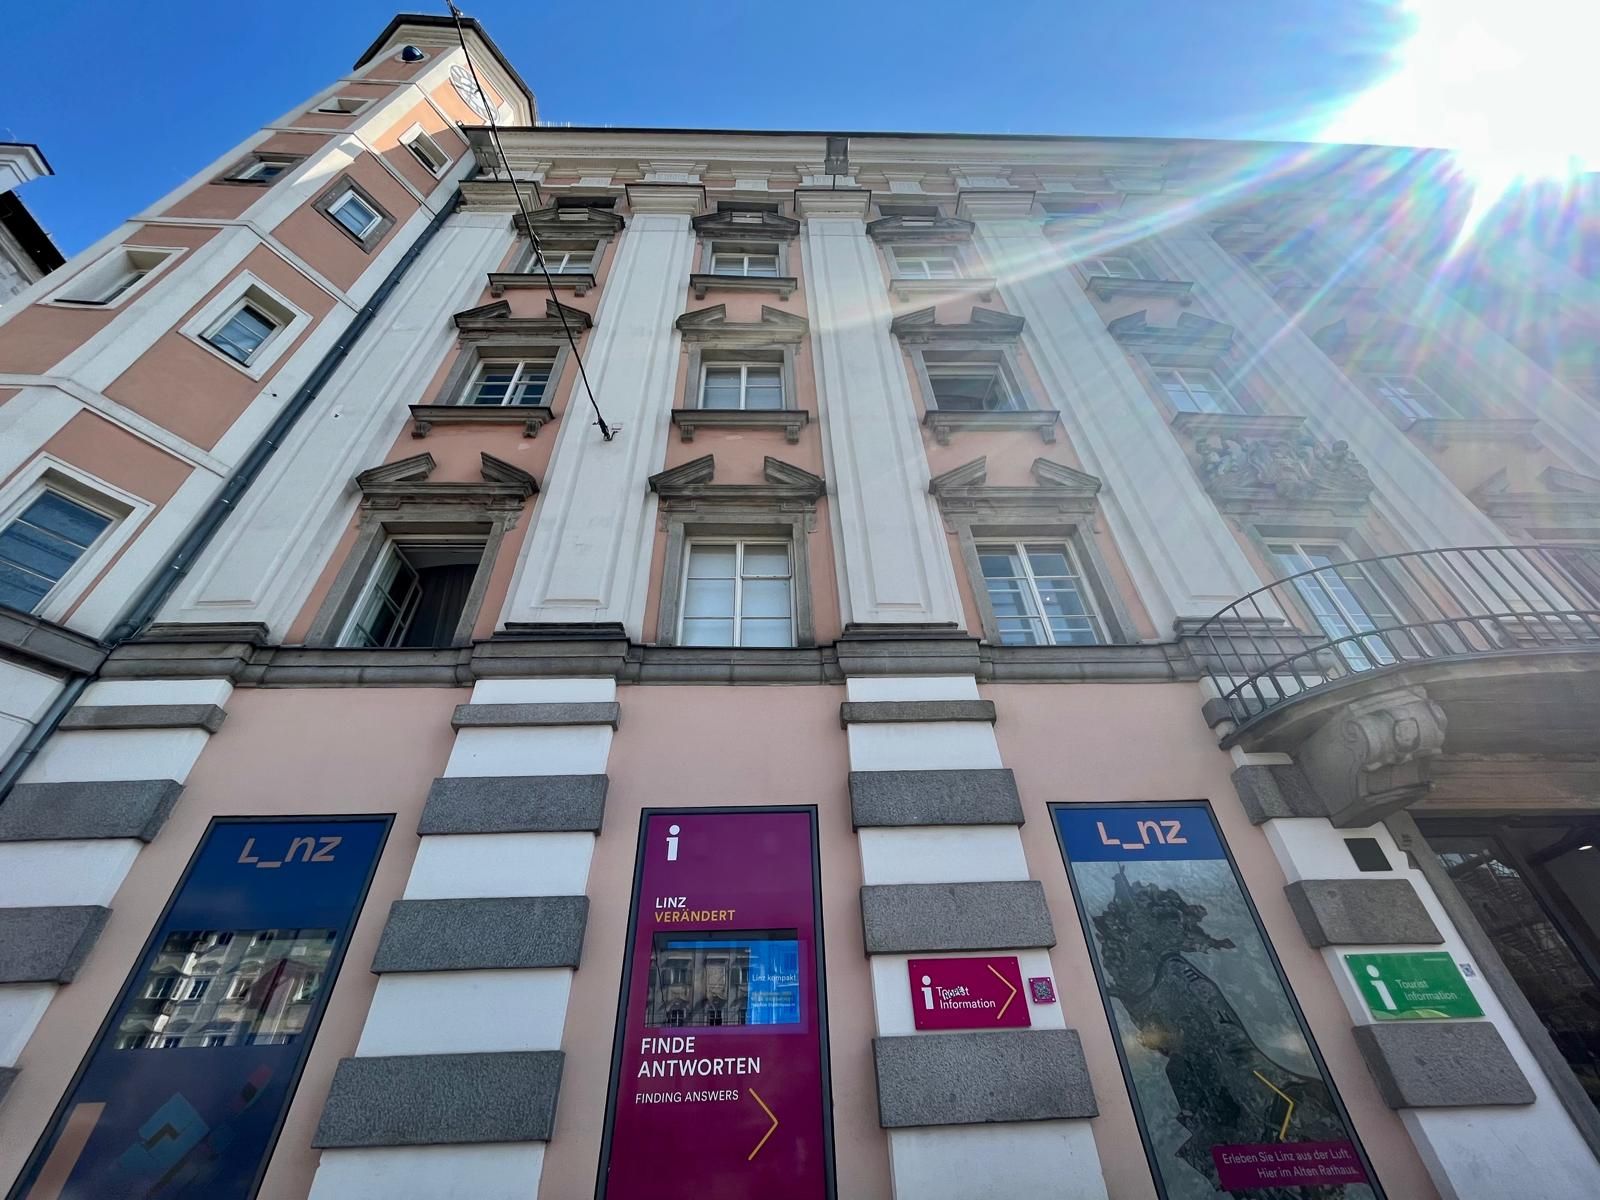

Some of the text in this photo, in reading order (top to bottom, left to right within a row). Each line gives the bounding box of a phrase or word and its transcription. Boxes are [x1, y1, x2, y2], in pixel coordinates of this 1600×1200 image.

[655, 896, 687, 909] LINZ
[654, 908, 736, 923] VERÄNDERT
[1394, 979, 1429, 989] Tourist
[1403, 990, 1458, 1001] Information
[940, 998, 996, 1010] Information
[641, 1036, 696, 1055] FINDE
[637, 1056, 761, 1078] ANTWORTEN
[635, 1089, 739, 1105] FINDING ANSWERS
[1222, 1152, 1258, 1164] Erleben
[1258, 1151, 1274, 1162] Sie
[1274, 1151, 1295, 1161] Linz
[1295, 1152, 1312, 1161] aus
[1313, 1149, 1328, 1160] der
[1257, 1167, 1277, 1178] Hier
[1278, 1167, 1292, 1177] im
[1293, 1165, 1319, 1177] Alten
